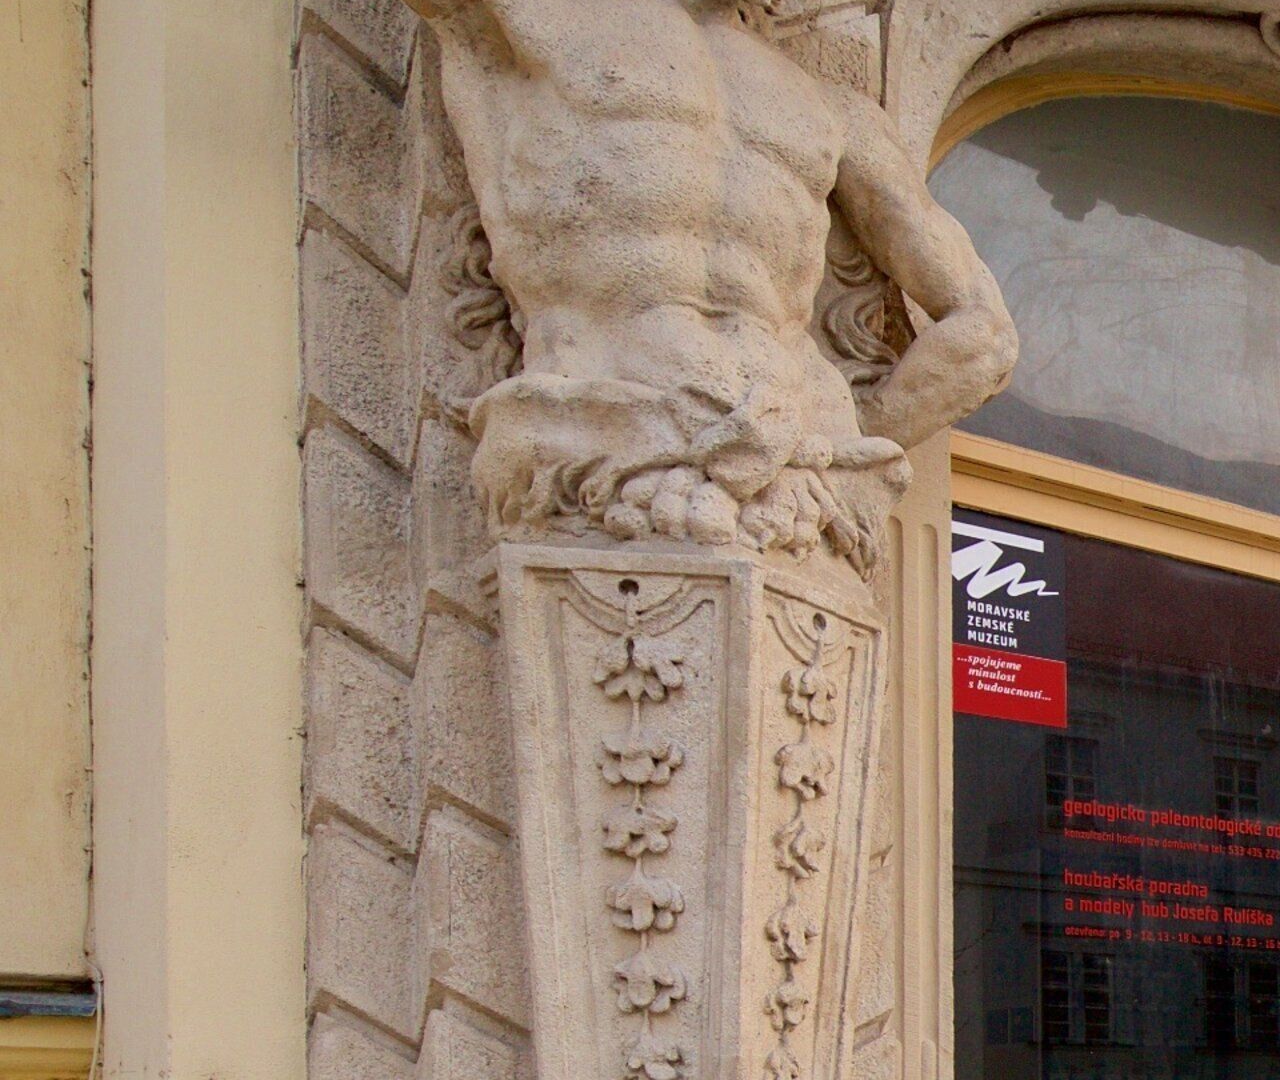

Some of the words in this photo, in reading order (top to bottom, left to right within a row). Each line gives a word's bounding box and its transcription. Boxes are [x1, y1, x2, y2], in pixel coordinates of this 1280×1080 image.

[967, 600, 1030, 622] MORAVSKÉ
[967, 615, 1014, 633] ZEMSKÉ
[967, 630, 1018, 648] MUZEUM
[968, 666, 1016, 682] minulost
[1064, 799, 1146, 822] geologicko
[1150, 809, 1262, 836] paleontologické
[1064, 868, 1144, 891] houbařská
[1149, 880, 1208, 897] poradna
[1064, 898, 1074, 911] a
[1080, 898, 1135, 918] modely
[1142, 901, 1169, 918] hub
[1172, 903, 1219, 922] Josefa
[1224, 906, 1274, 926] Rulíška
